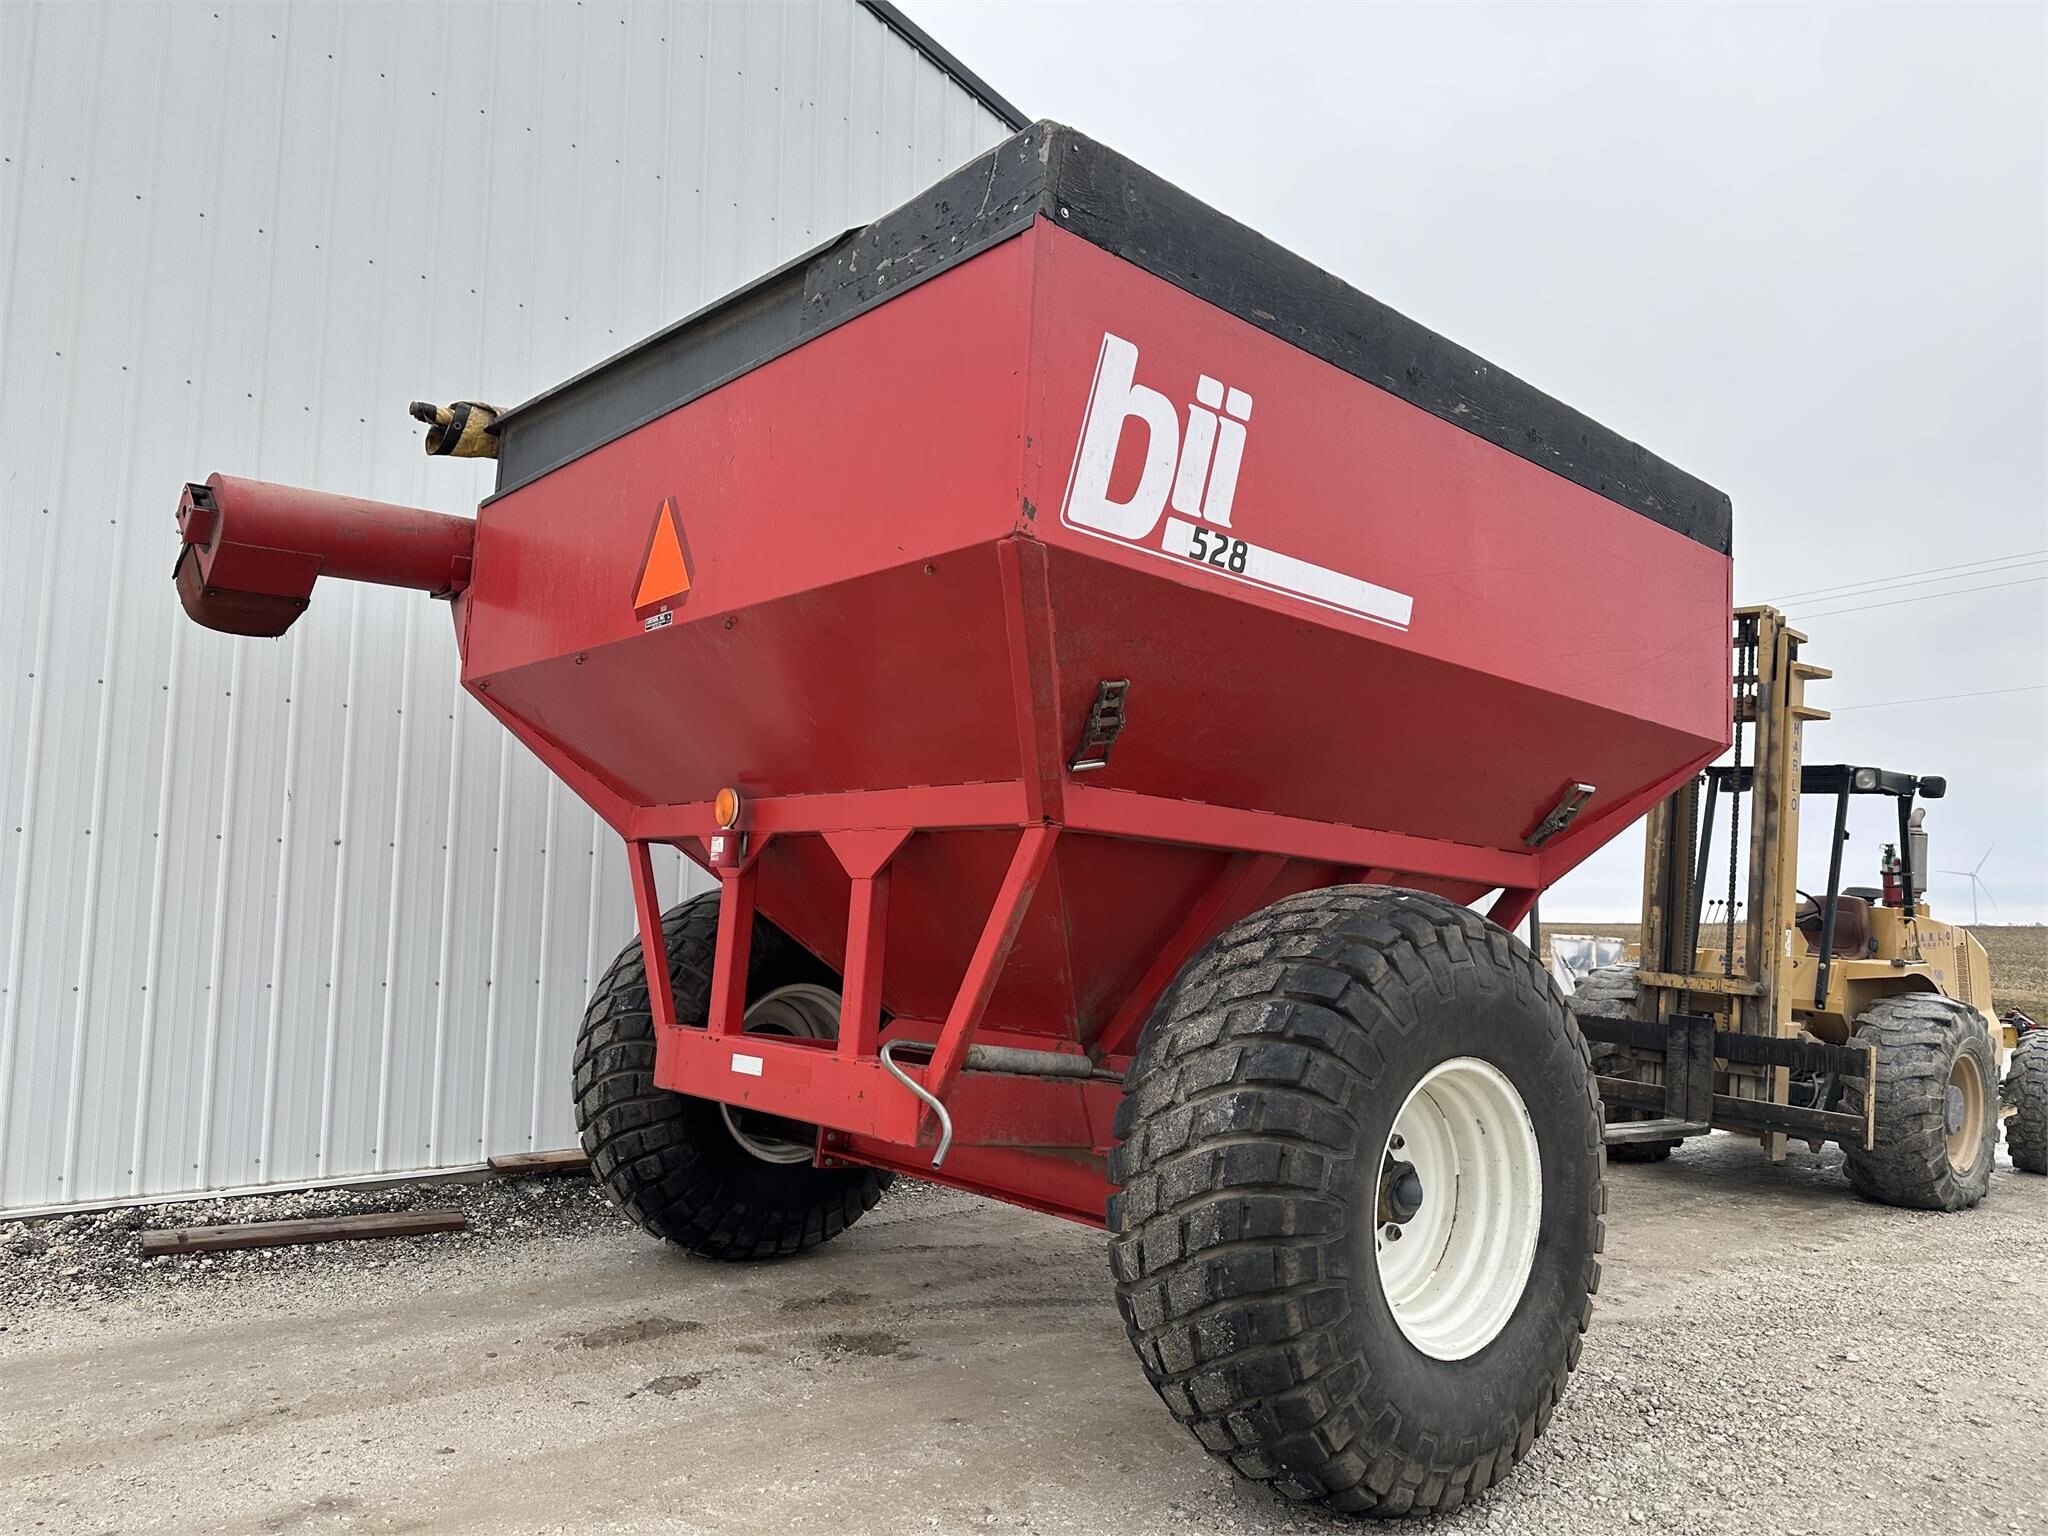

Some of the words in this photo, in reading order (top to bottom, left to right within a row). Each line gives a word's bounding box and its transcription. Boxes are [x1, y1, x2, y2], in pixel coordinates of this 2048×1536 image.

[1066, 332, 1253, 540] bii
[1189, 526, 1248, 573] 528
[1791, 722, 1800, 811] HARLO
